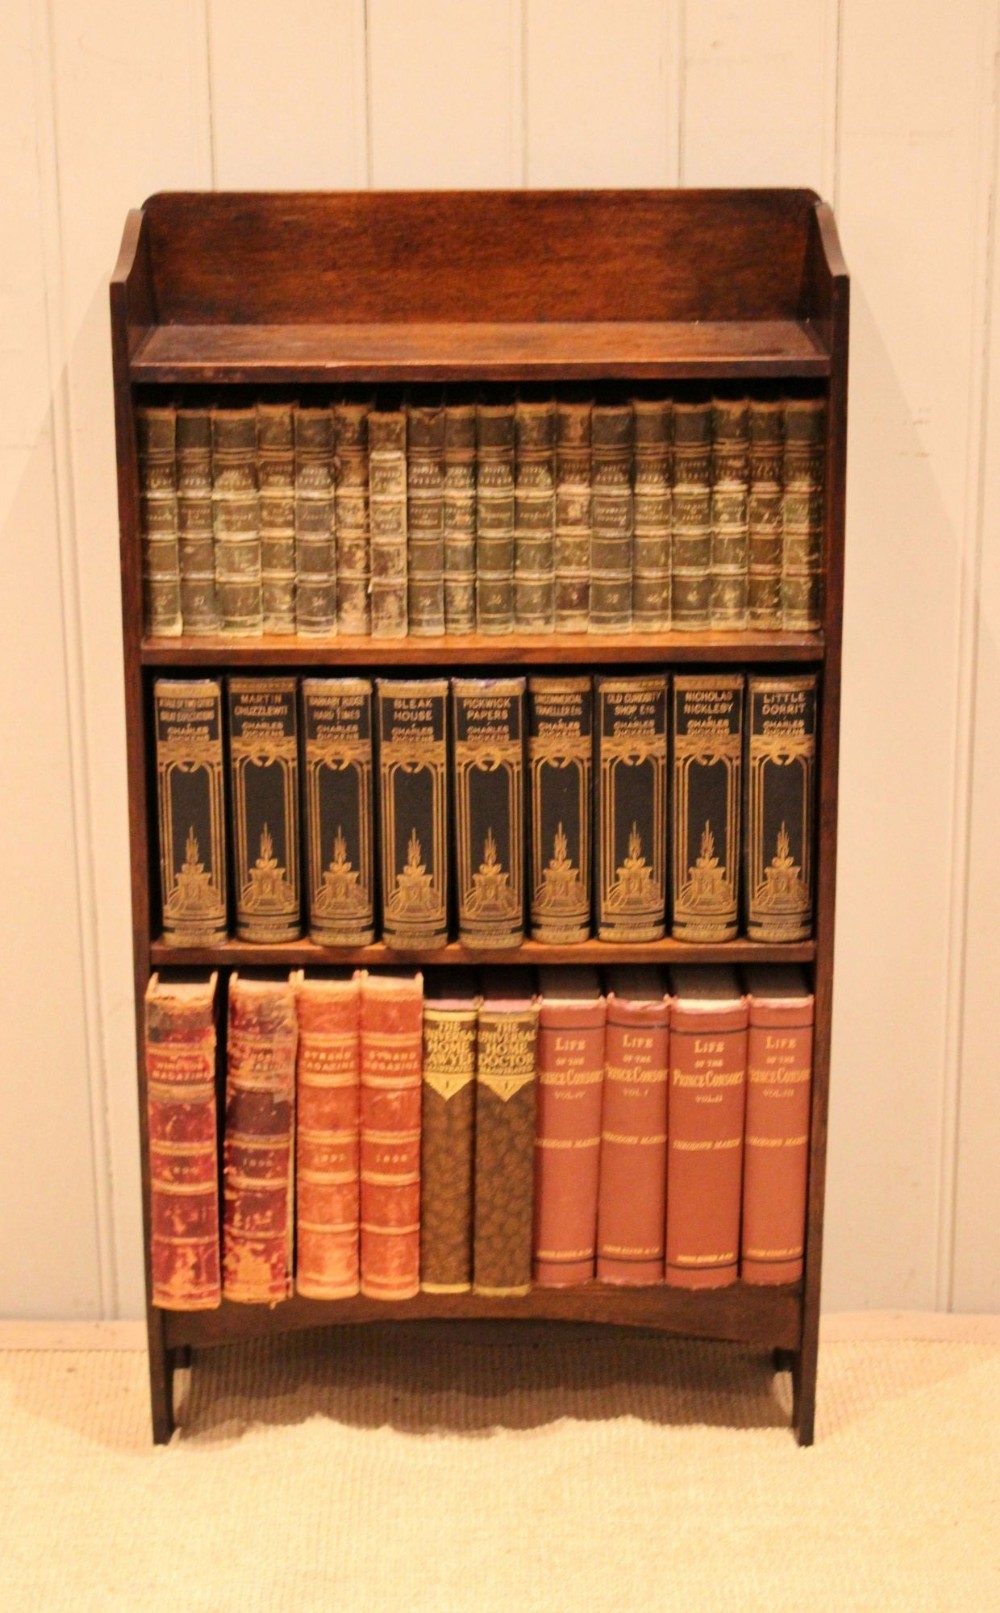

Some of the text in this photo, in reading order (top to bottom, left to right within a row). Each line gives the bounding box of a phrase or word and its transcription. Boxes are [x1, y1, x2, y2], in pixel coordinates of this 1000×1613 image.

[241, 694, 282, 704] MARTIN
[685, 691, 733, 702] NICHOLAS
[763, 693, 805, 703] LITTLE
[393, 698, 433, 709] BLEAK
[463, 697, 511, 709] PICKWICK
[683, 702, 734, 714] NICKLEBY
[234, 705, 288, 716] CHUZZLEWIT
[467, 709, 508, 720] PAPERS
[614, 705, 638, 716] SHOP
[762, 703, 806, 715] DORRIT
[393, 710, 433, 721] HOUSE
[496, 1022, 520, 1033] THE
[428, 1040, 470, 1052] HOME
[555, 1037, 586, 1051] LIFE
[623, 1034, 653, 1048] LIFE
[695, 1040, 725, 1053] LIFE
[766, 1036, 796, 1049] LIFE
[486, 1041, 529, 1054] HOME
[304, 1050, 352, 1061] STRAND
[368, 1050, 417, 1061] STRAND
[479, 1053, 534, 1067] DOCTOR
[673, 1069, 744, 1088] PRINCE CONSORT
